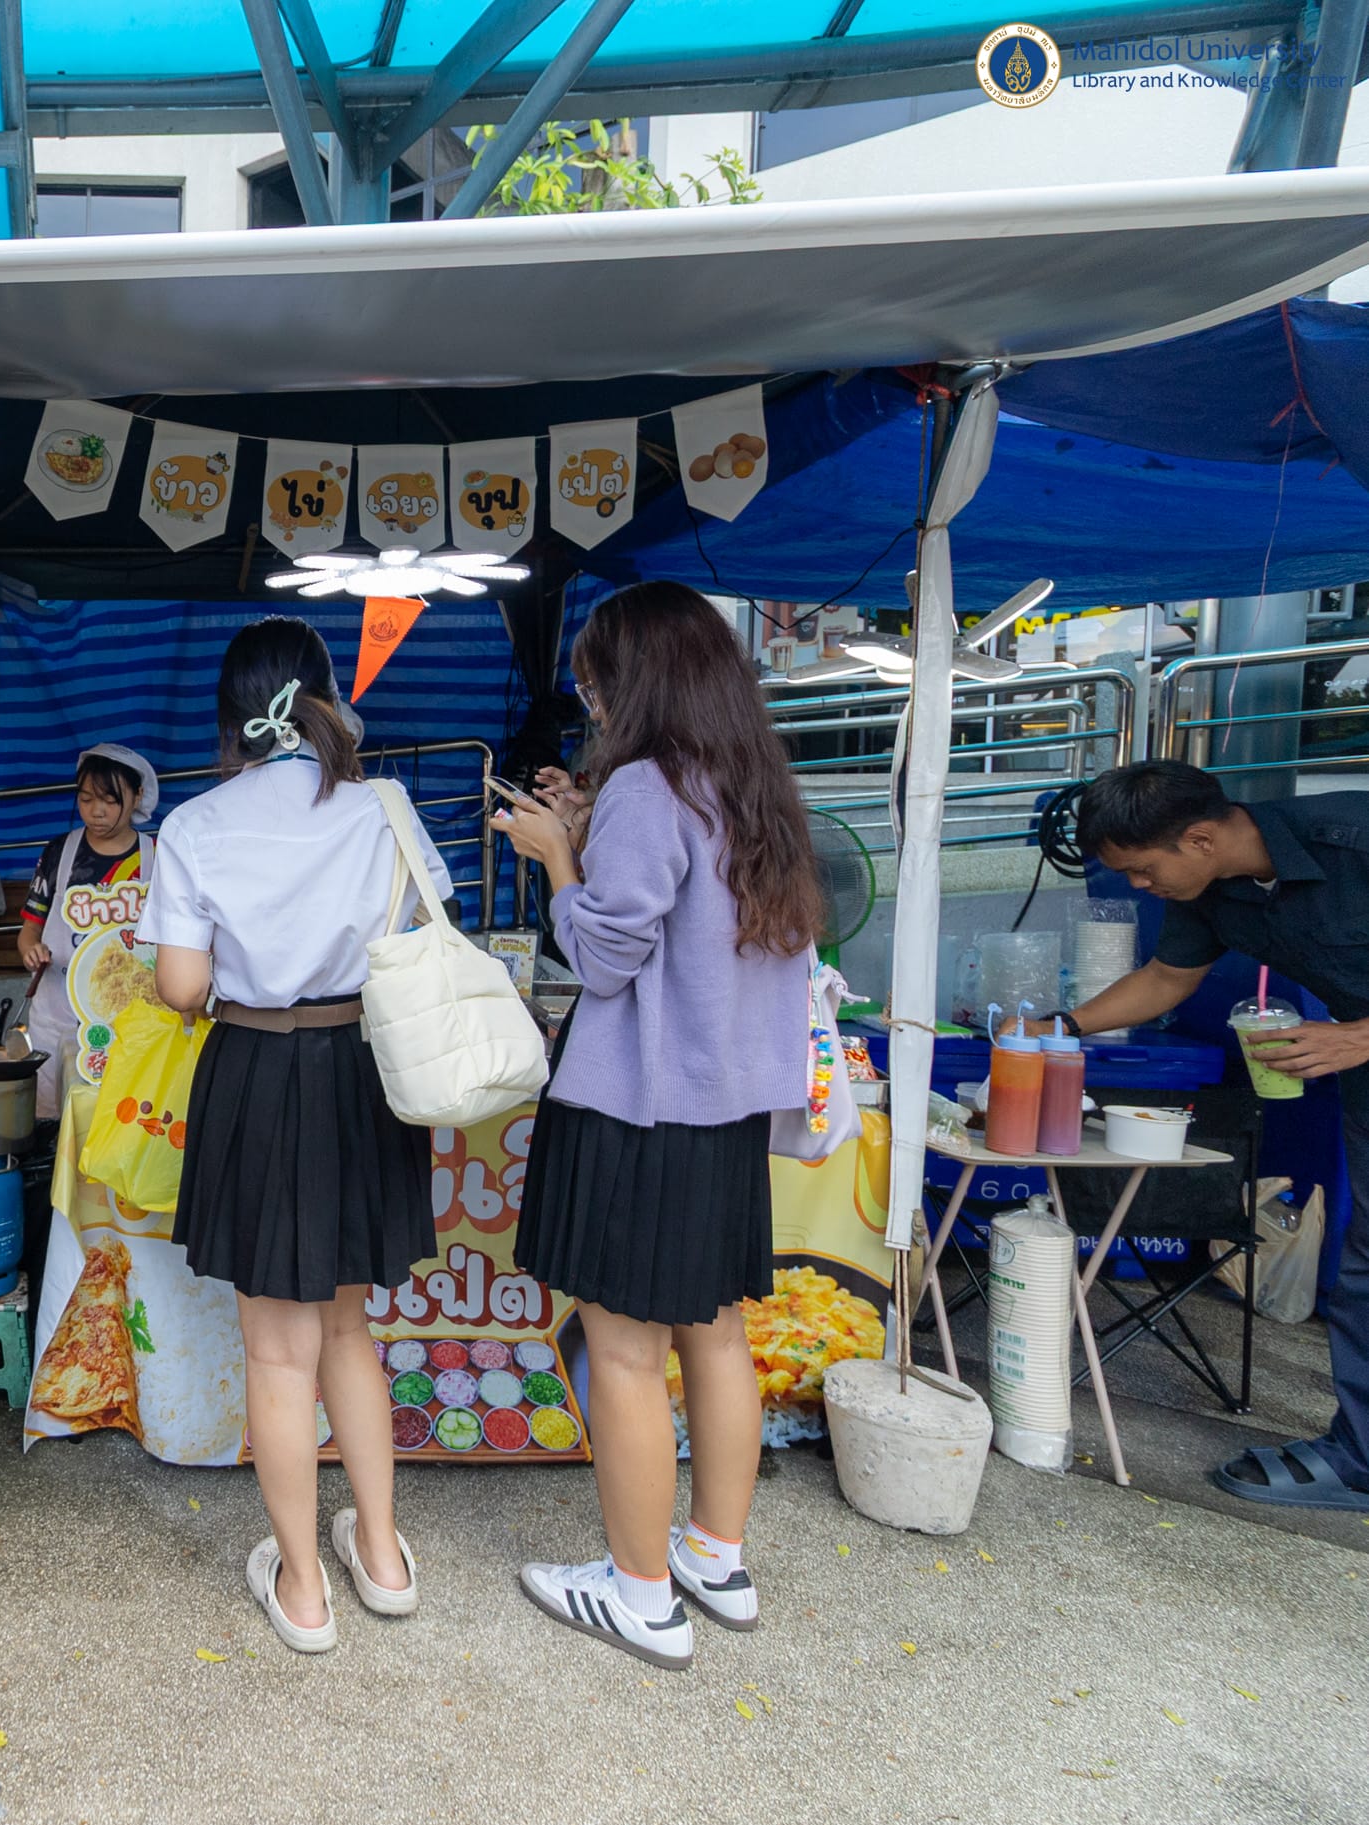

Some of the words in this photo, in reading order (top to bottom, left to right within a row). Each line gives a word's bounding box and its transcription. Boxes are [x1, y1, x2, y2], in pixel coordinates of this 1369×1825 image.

[153, 459, 220, 508] ข้าว
[280, 477, 326, 519] ไข่
[365, 480, 439, 519] เจียว
[467, 477, 521, 531] บุฟ
[557, 453, 626, 501] เฟ่ต์
